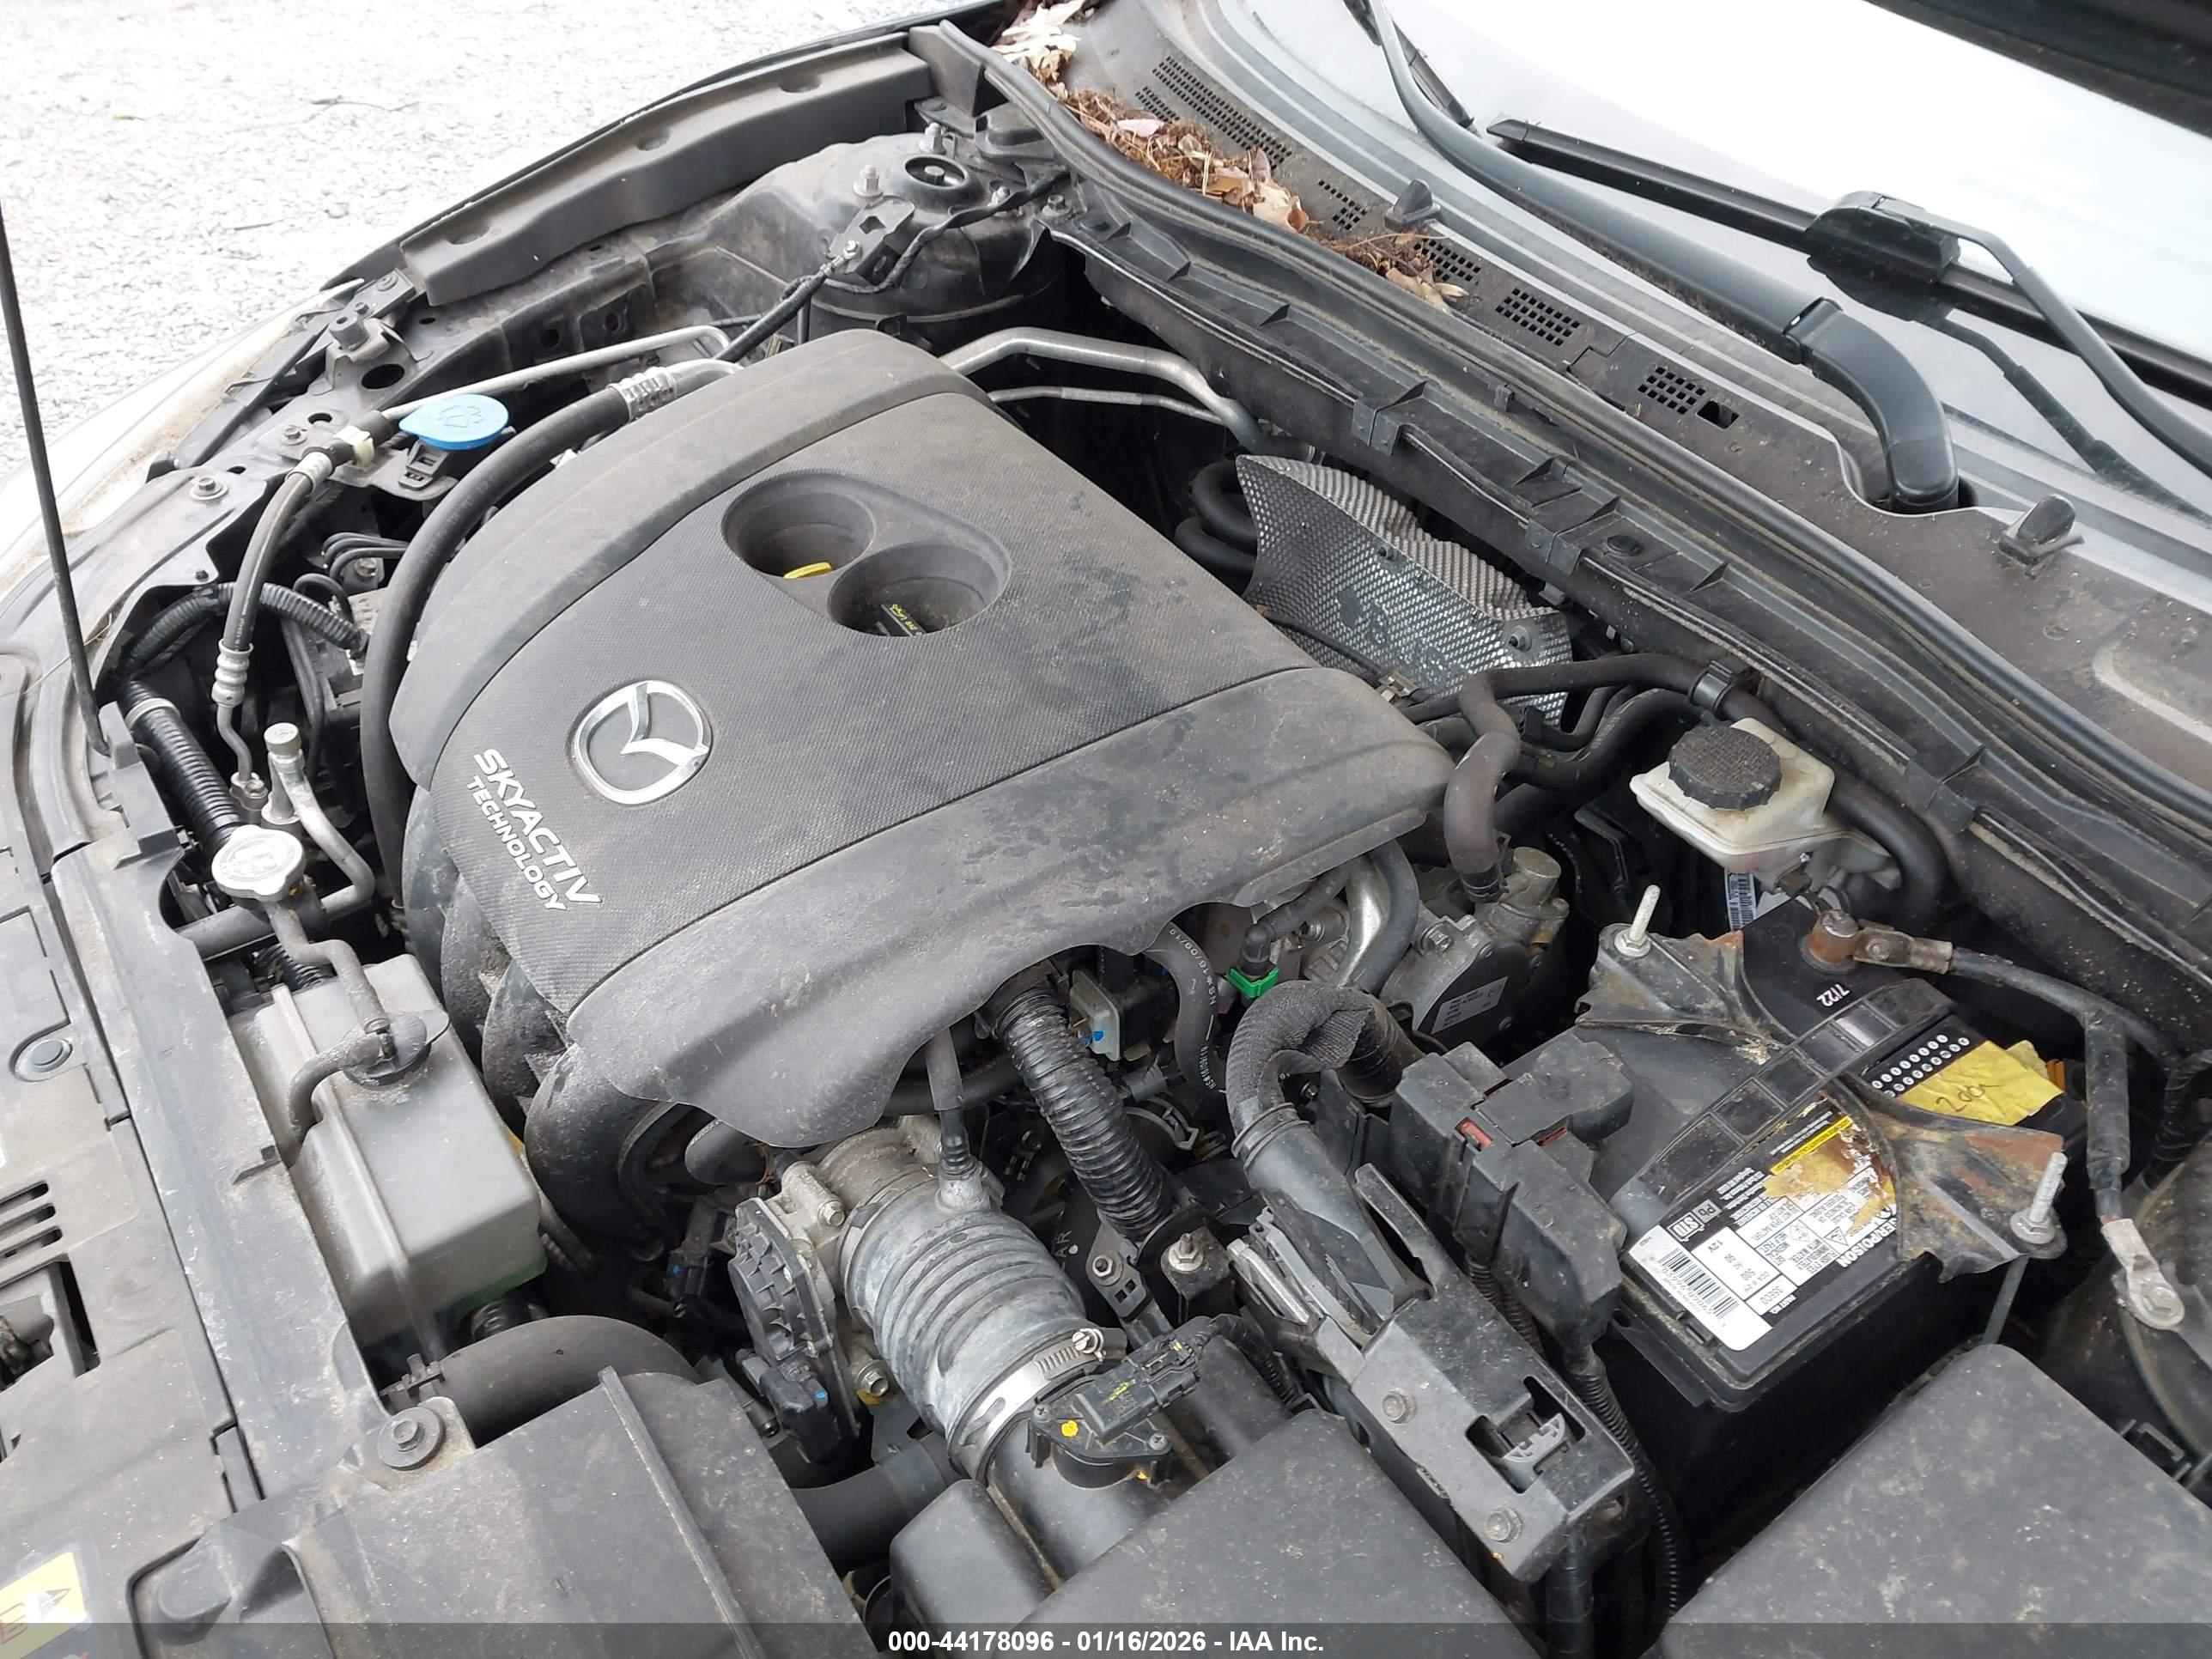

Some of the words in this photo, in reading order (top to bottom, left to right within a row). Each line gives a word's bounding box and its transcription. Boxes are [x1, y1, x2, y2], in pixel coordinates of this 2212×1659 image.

[473, 749, 602, 904] SKYACTIV
[464, 775, 568, 912] TECHNOLOGY
[1816, 983, 1850, 1007] 7/22
[1697, 1202, 1716, 1219] Pb
[1706, 1238, 1723, 1253] 12V
[1778, 1294, 1796, 1308] PART
